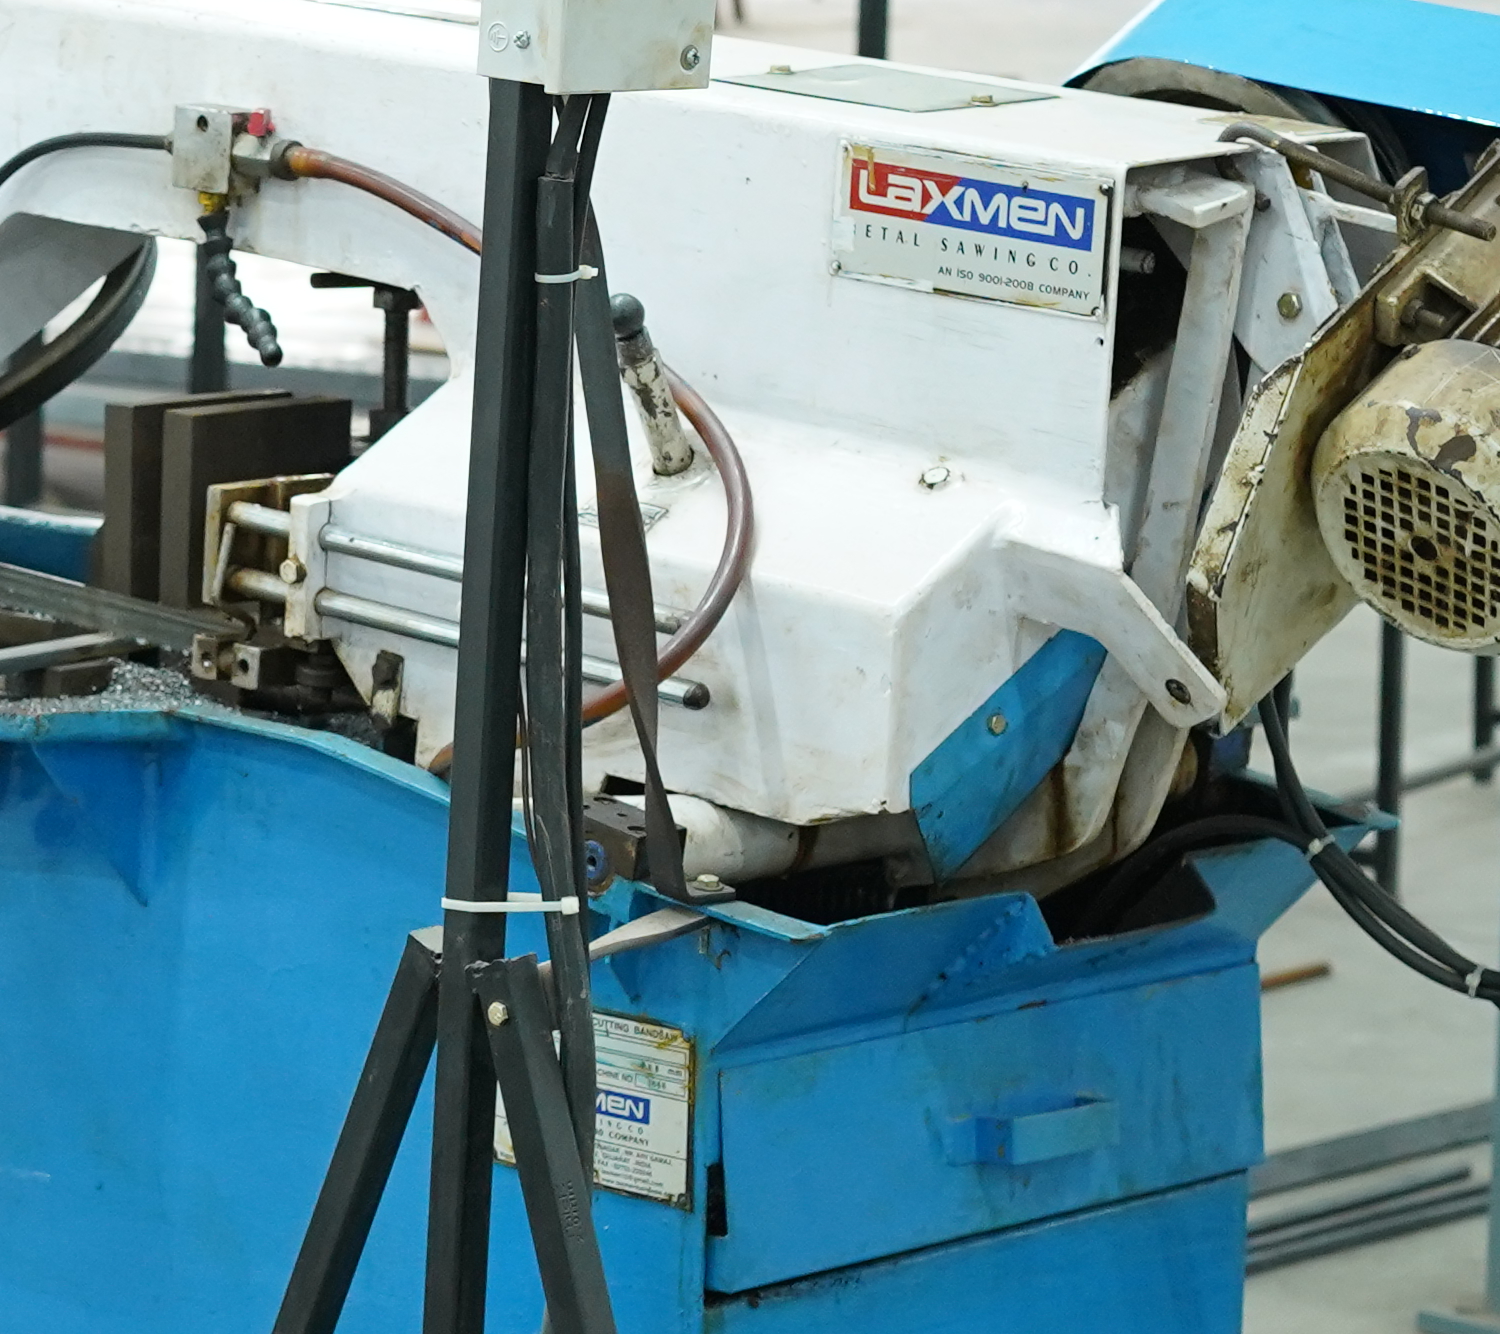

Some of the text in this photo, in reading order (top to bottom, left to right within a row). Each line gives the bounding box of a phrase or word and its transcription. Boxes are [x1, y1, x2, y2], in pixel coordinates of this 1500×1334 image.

[853, 223, 921, 248] ETAL
[940, 237, 1036, 268] SAWING
[937, 265, 953, 277] AN
[956, 267, 974, 281] ISO
[1038, 283, 1091, 302] COMPANY
